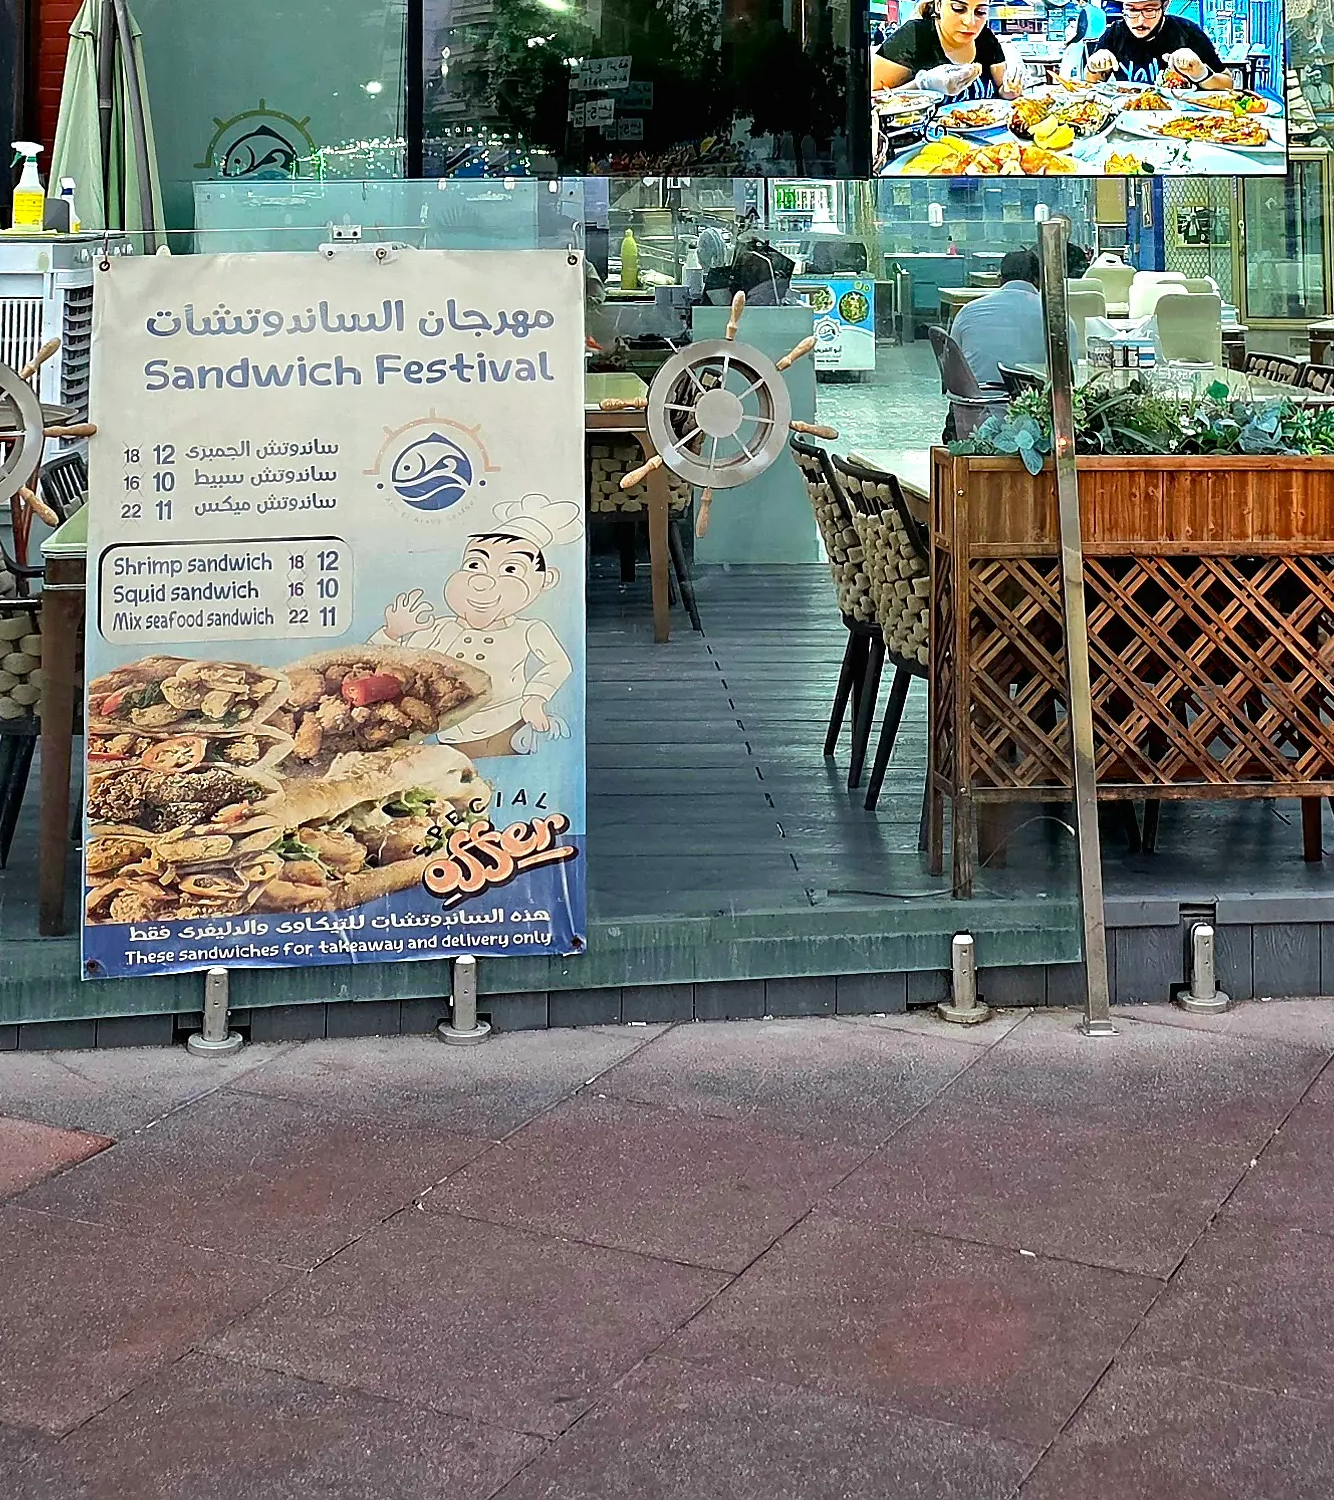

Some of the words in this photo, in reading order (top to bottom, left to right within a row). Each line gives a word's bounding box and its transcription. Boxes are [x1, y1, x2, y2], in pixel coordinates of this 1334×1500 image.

[146, 298, 404, 338] الساندوتشات
[418, 298, 556, 338] مهرجان
[144, 355, 363, 391] Sandwich
[375, 350, 556, 386] Festival
[123, 448, 141, 464] 18
[152, 444, 176, 466] 12
[255, 438, 339, 461] ساندوتش
[123, 475, 140, 491] 16
[152, 471, 176, 493] 10
[193, 468, 244, 489] سبيط
[250, 465, 338, 488] ساندوتش
[120, 503, 142, 519] 22
[155, 499, 173, 521] 11
[194, 495, 251, 517] ميكس
[256, 492, 337, 514] ساندوتش
[114, 556, 183, 578] Shrimp
[187, 552, 273, 573] sandwich
[287, 554, 305, 570] 18
[316, 550, 339, 572] 12
[113, 583, 166, 607] Squid
[170, 580, 259, 602] sandwich
[287, 582, 304, 597] 16
[316, 577, 339, 599] 10
[113, 610, 142, 631] Mix
[145, 609, 204, 630] seafood
[206, 607, 274, 627] sandwich
[288, 608, 309, 625] 22
[319, 605, 337, 627] 11
[412, 788, 551, 858] SPECIAL
[510, 908, 551, 922] هذه
[129, 925, 171, 942] فقط
[124, 949, 175, 965] These
[178, 943, 279, 961] sandwiches
[318, 938, 404, 955] takeaway
[407, 934, 438, 950] and
[441, 932, 509, 948] delivery
[512, 929, 553, 947] only
